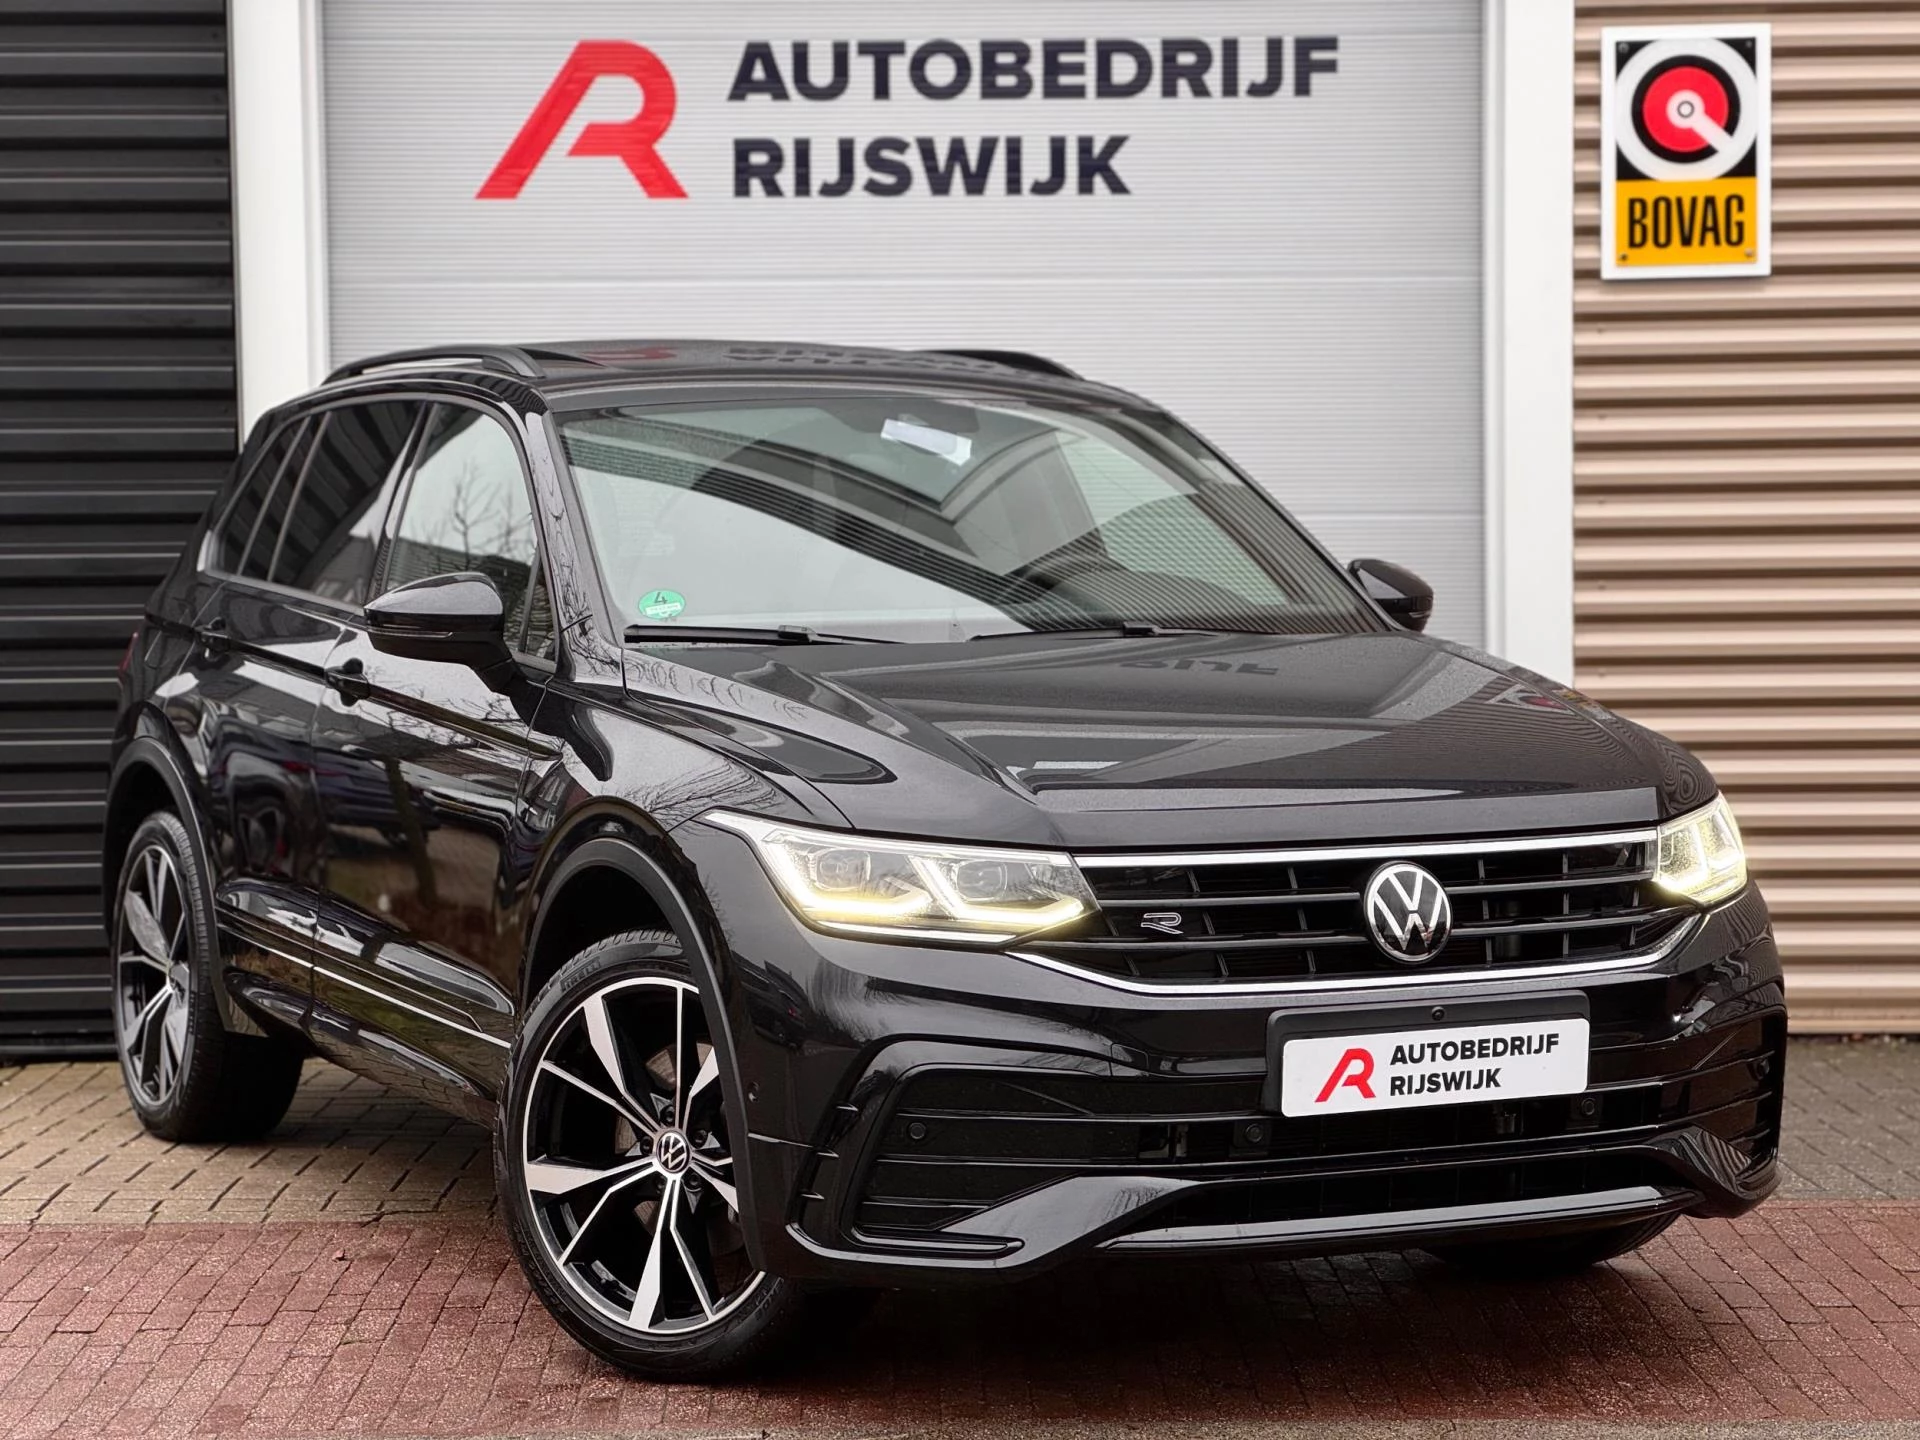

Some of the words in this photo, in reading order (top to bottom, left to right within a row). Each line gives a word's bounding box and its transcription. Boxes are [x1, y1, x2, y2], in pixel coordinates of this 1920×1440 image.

[727, 37, 1339, 102] AUTOBEDRIJF
[733, 136, 1131, 198] RIJSWIJK
[1628, 194, 1744, 248] BOVAG
[1389, 1033, 1559, 1066] AUTOBEDRIJF
[1389, 1068, 1502, 1097] RIJSWIJK
